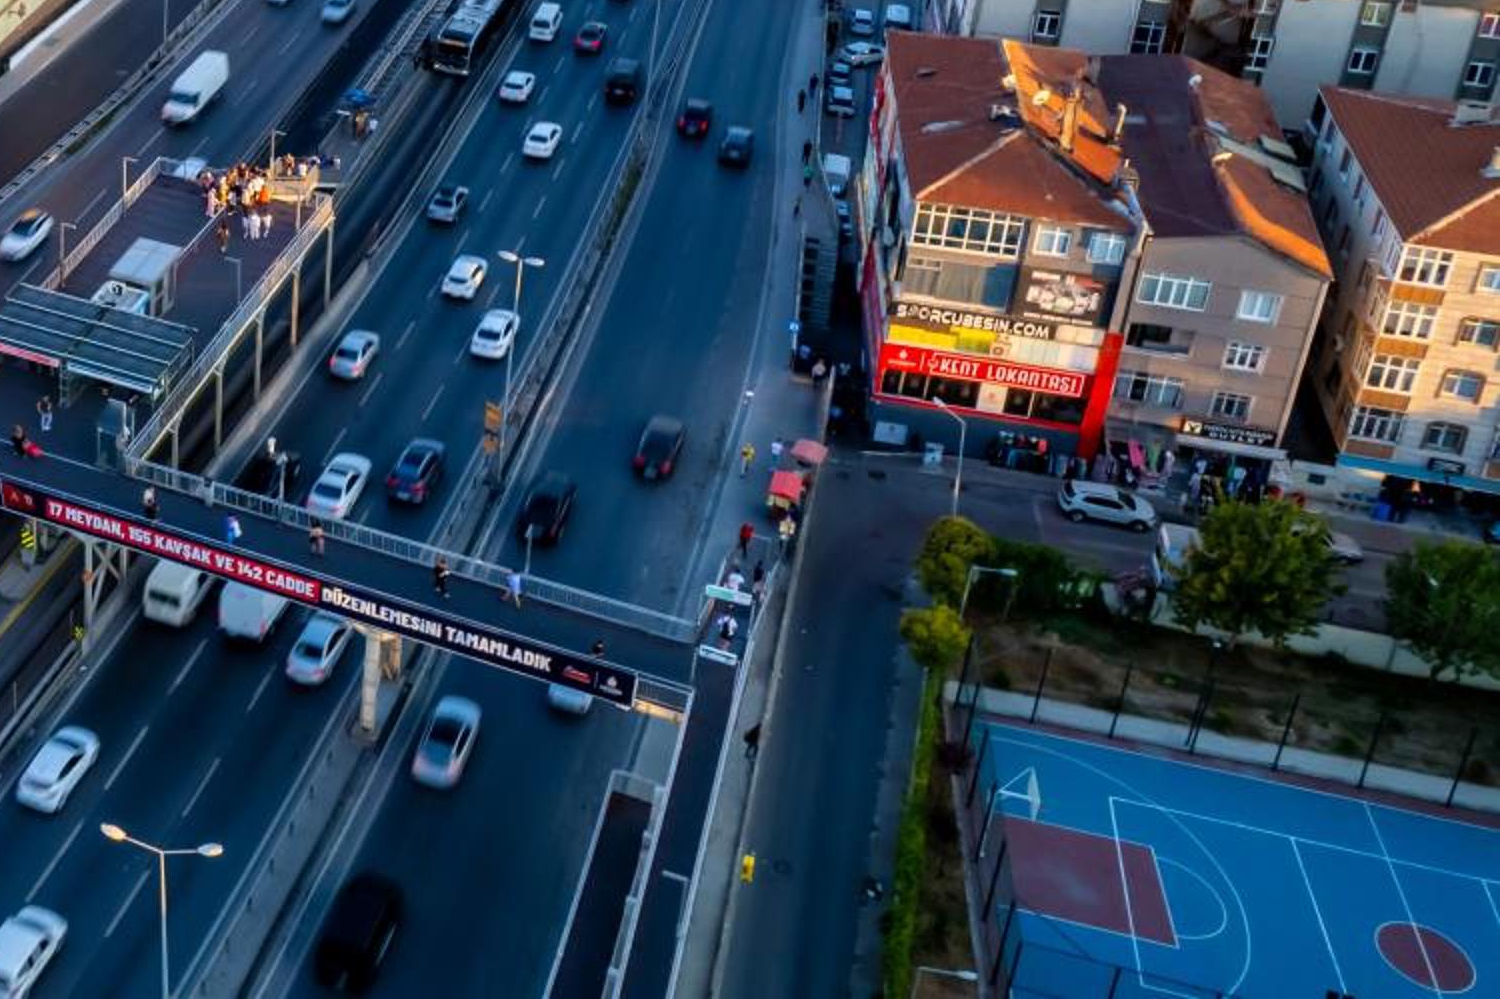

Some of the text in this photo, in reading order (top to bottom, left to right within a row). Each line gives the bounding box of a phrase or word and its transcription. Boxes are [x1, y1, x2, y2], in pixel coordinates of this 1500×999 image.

[49, 501, 63, 518] 17
[65, 506, 126, 539] MEYDAN,
[129, 525, 152, 544] 155
[155, 534, 211, 565] KAVŞAK
[215, 553, 236, 573] VE
[236, 559, 264, 582] 142
[265, 570, 316, 599] CADDE
[445, 625, 553, 673] TAMAMLADIK
